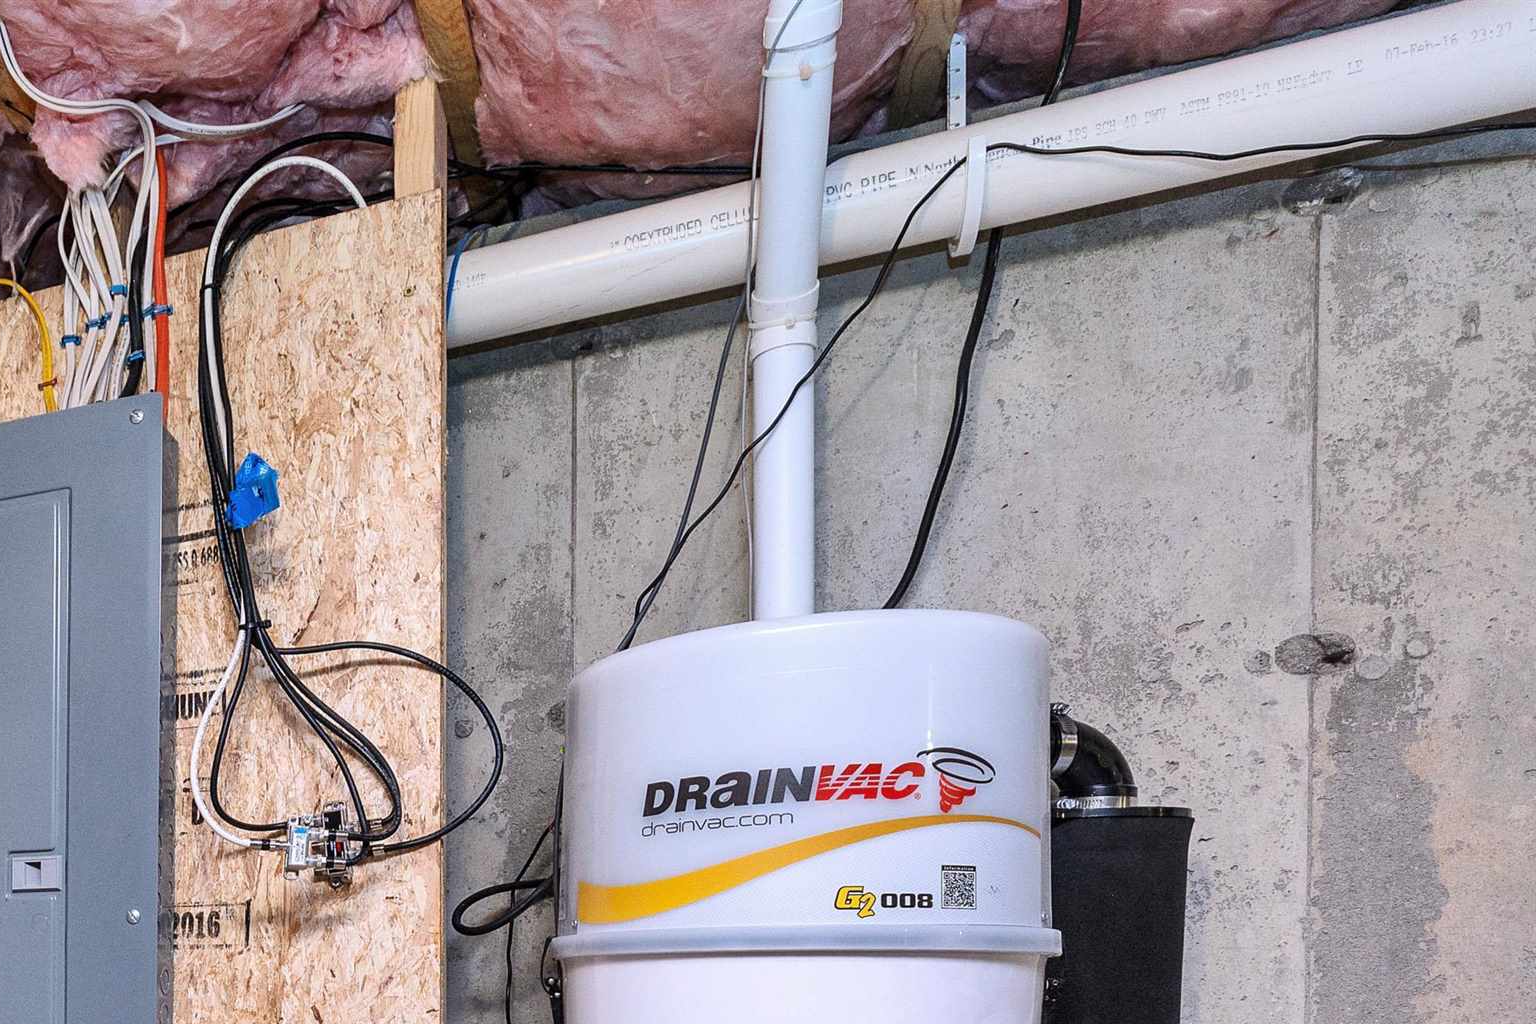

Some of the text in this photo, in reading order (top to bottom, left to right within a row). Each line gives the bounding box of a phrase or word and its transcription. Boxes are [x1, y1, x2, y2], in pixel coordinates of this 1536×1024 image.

[623, 218, 703, 249] COEXTRUDED
[860, 171, 897, 195] PIPE
[641, 811, 795, 838] drainvac.com
[834, 885, 934, 919] G2 008
